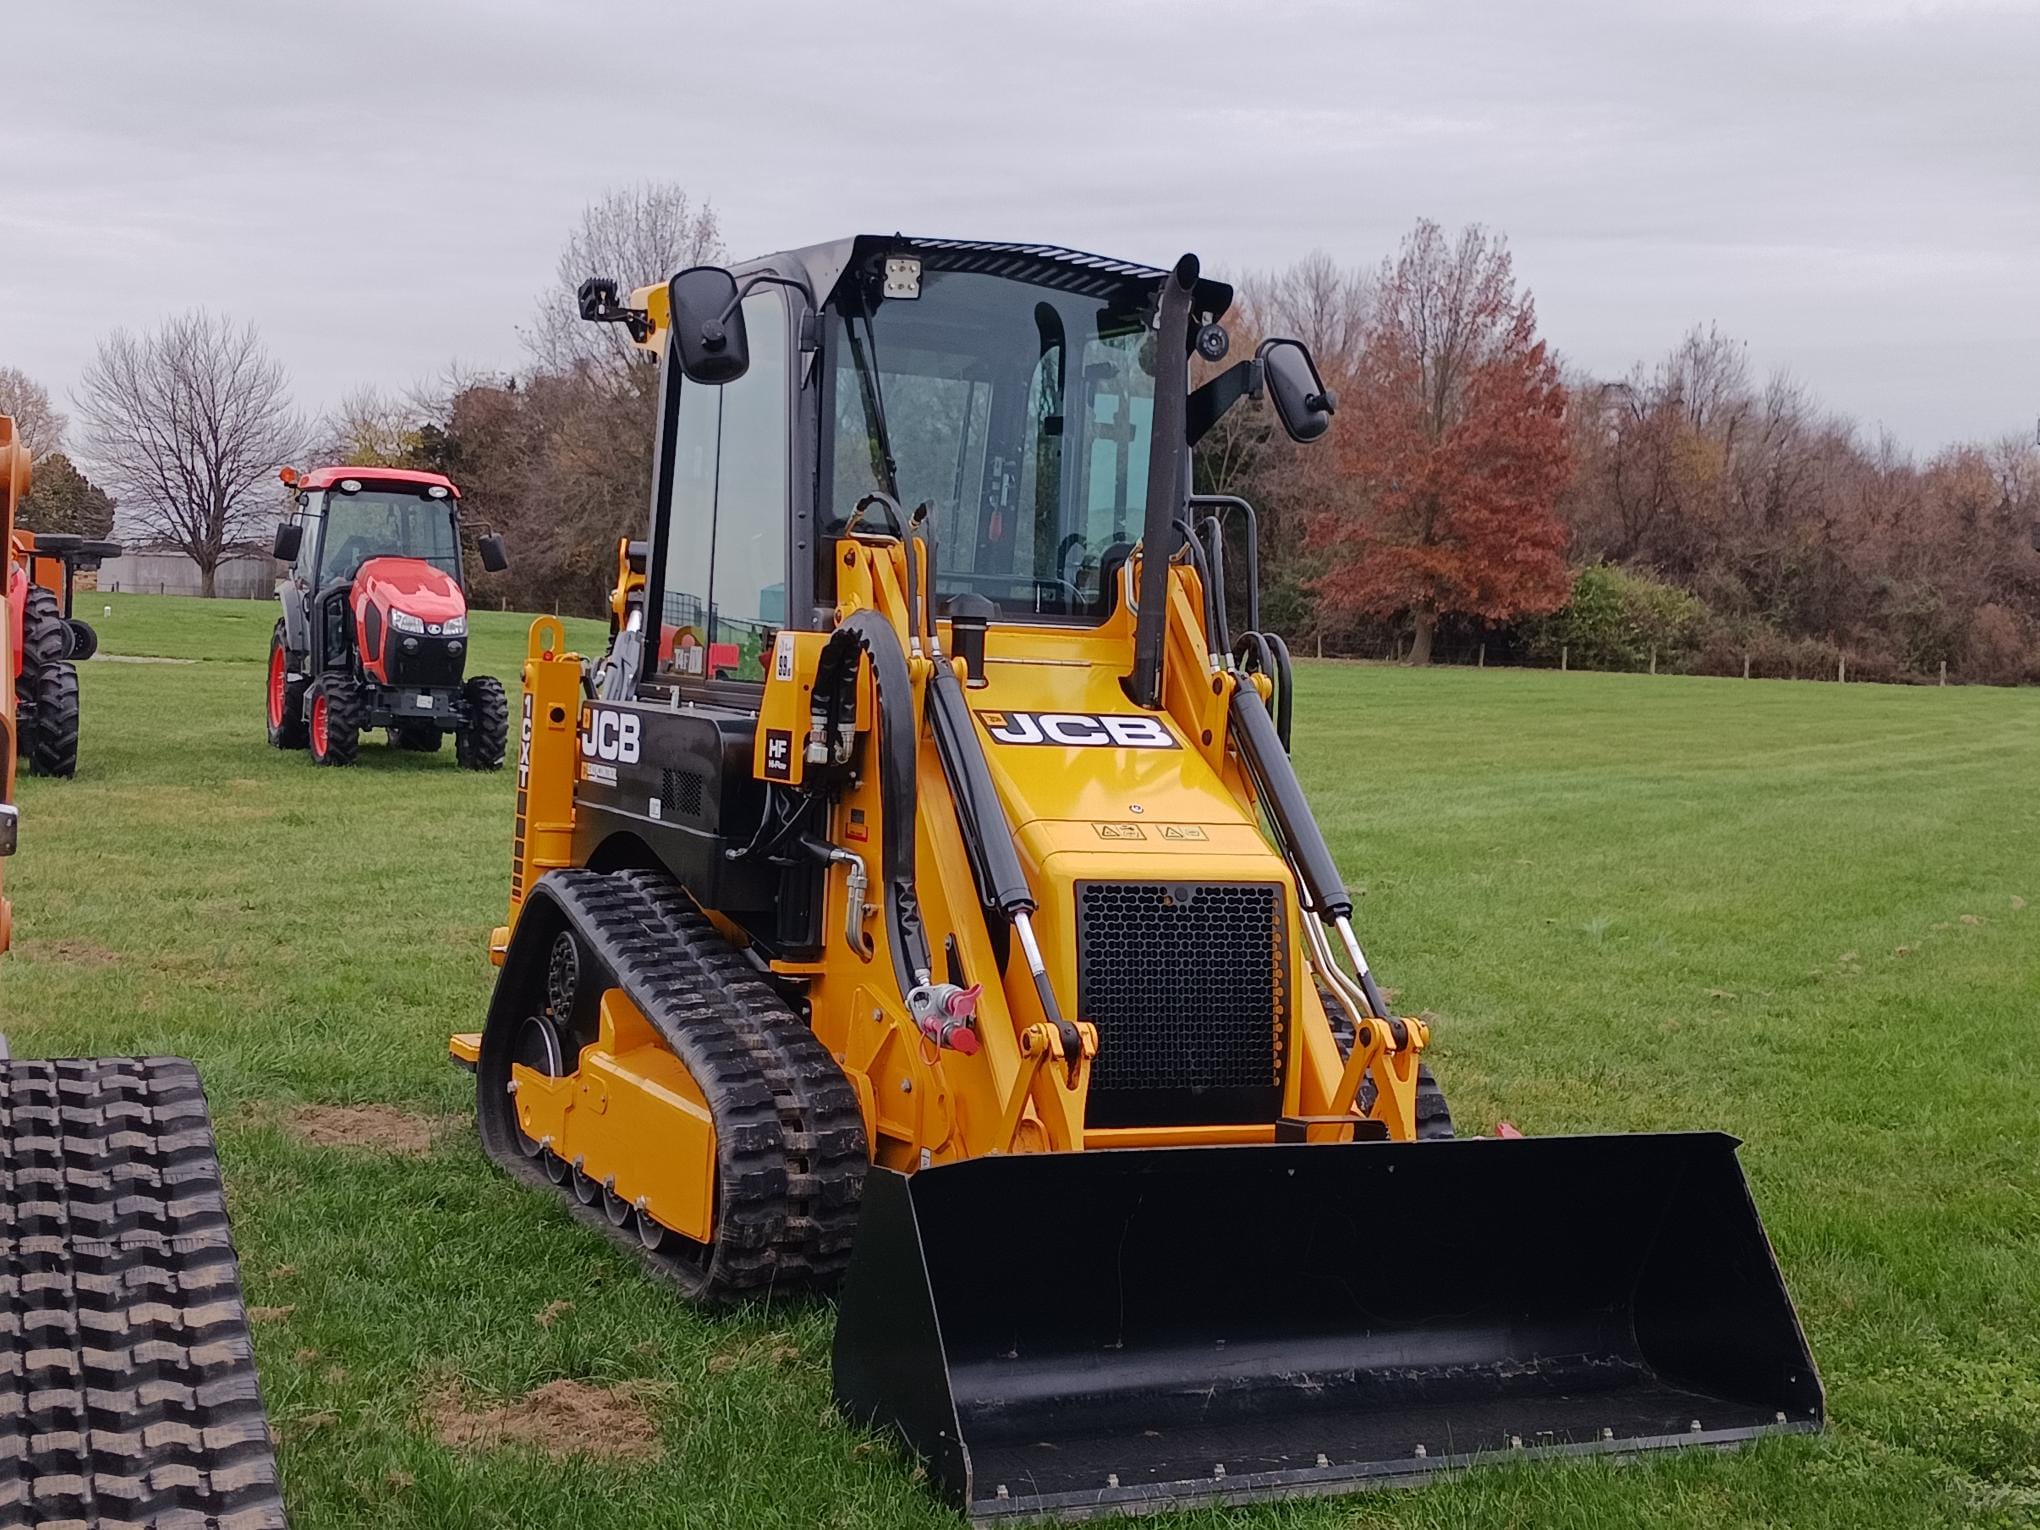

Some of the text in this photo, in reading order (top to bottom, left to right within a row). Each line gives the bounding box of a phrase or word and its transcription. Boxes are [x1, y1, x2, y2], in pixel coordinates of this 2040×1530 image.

[519, 693, 532, 788] 1CXT
[581, 708, 641, 764] JCB
[768, 738, 787, 758] HF
[990, 713, 1173, 747] JCB
